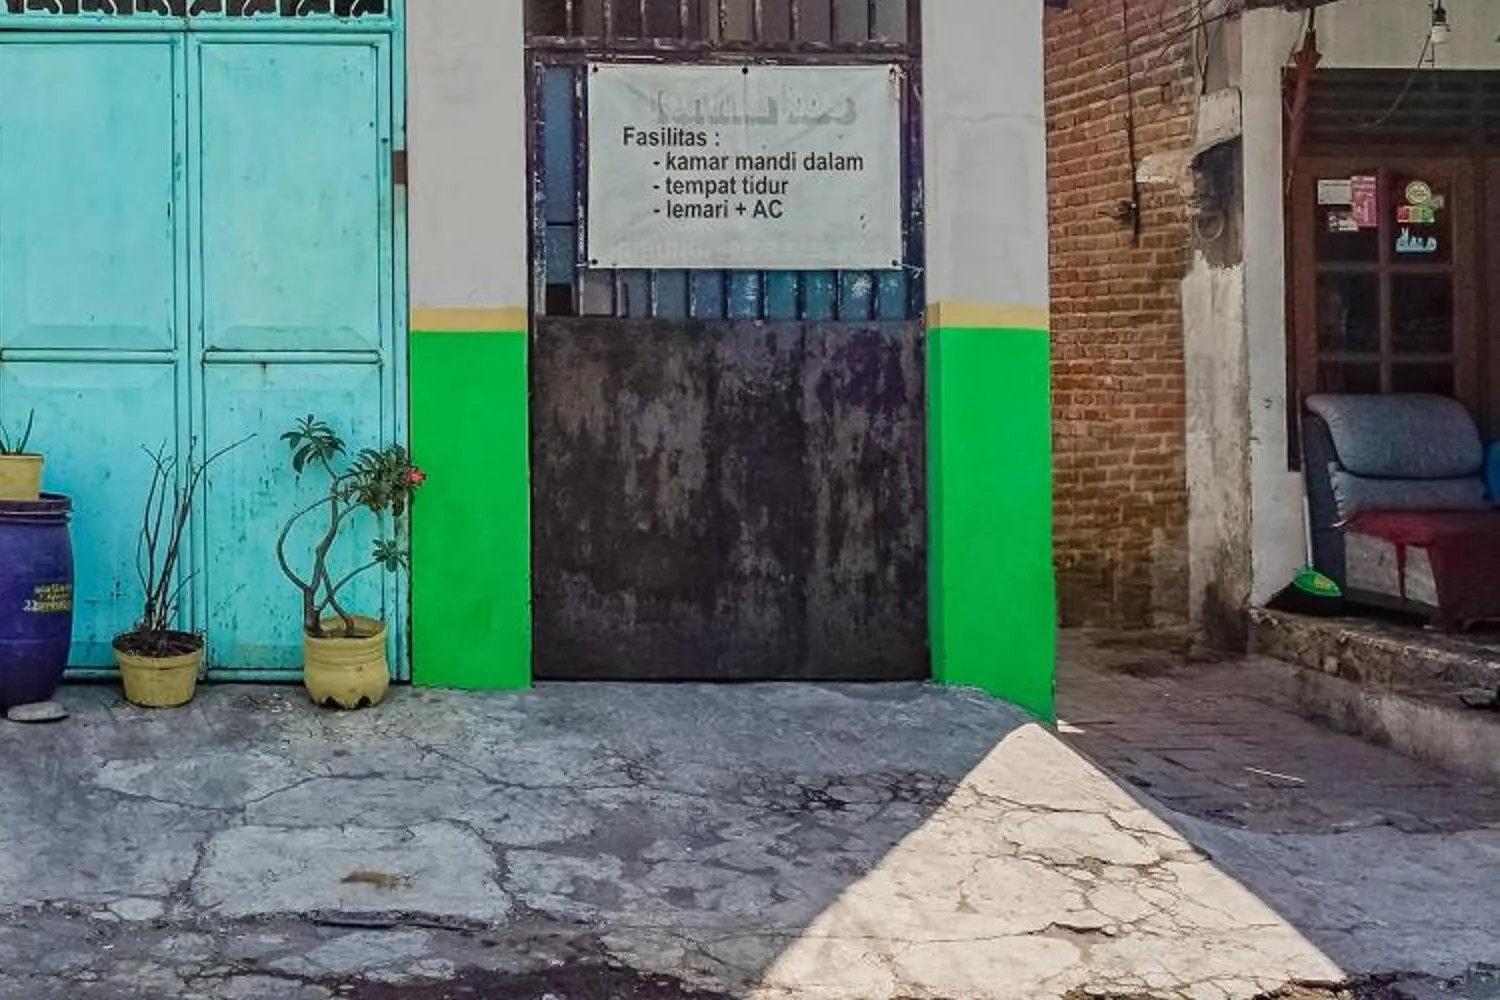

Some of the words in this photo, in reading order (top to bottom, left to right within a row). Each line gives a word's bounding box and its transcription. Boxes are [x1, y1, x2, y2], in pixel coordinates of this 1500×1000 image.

[622, 126, 708, 147] Fasilitas
[665, 151, 729, 171] kamar
[735, 151, 797, 171] mandi
[803, 151, 864, 171] dalam
[665, 176, 737, 198] tempat
[742, 176, 789, 195] tidur
[667, 200, 728, 218] lemari
[736, 203, 746, 215] +
[752, 200, 783, 218] AC
